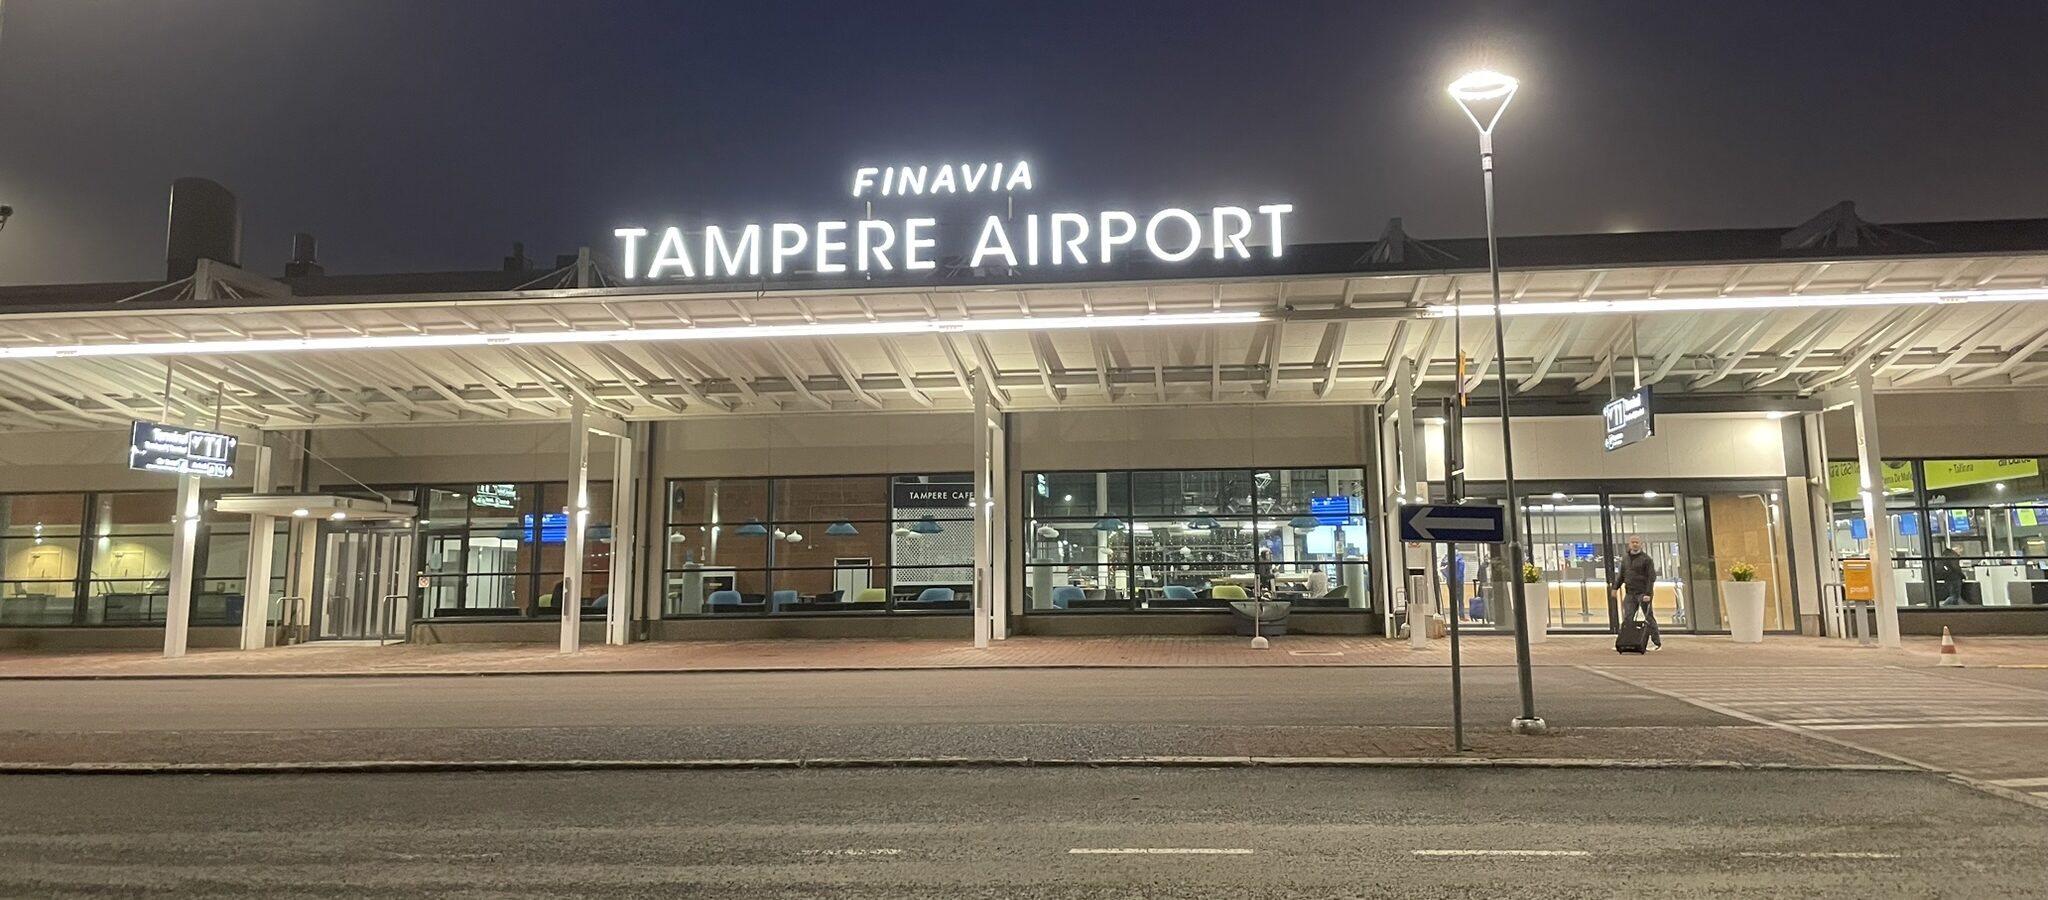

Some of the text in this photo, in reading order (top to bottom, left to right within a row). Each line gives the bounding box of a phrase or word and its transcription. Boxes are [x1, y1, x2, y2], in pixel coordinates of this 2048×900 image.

[853, 160, 1032, 197] FINAVIA
[614, 204, 1293, 279] TAMPERE AIRPORT
[910, 491, 948, 500] TAMPERE
